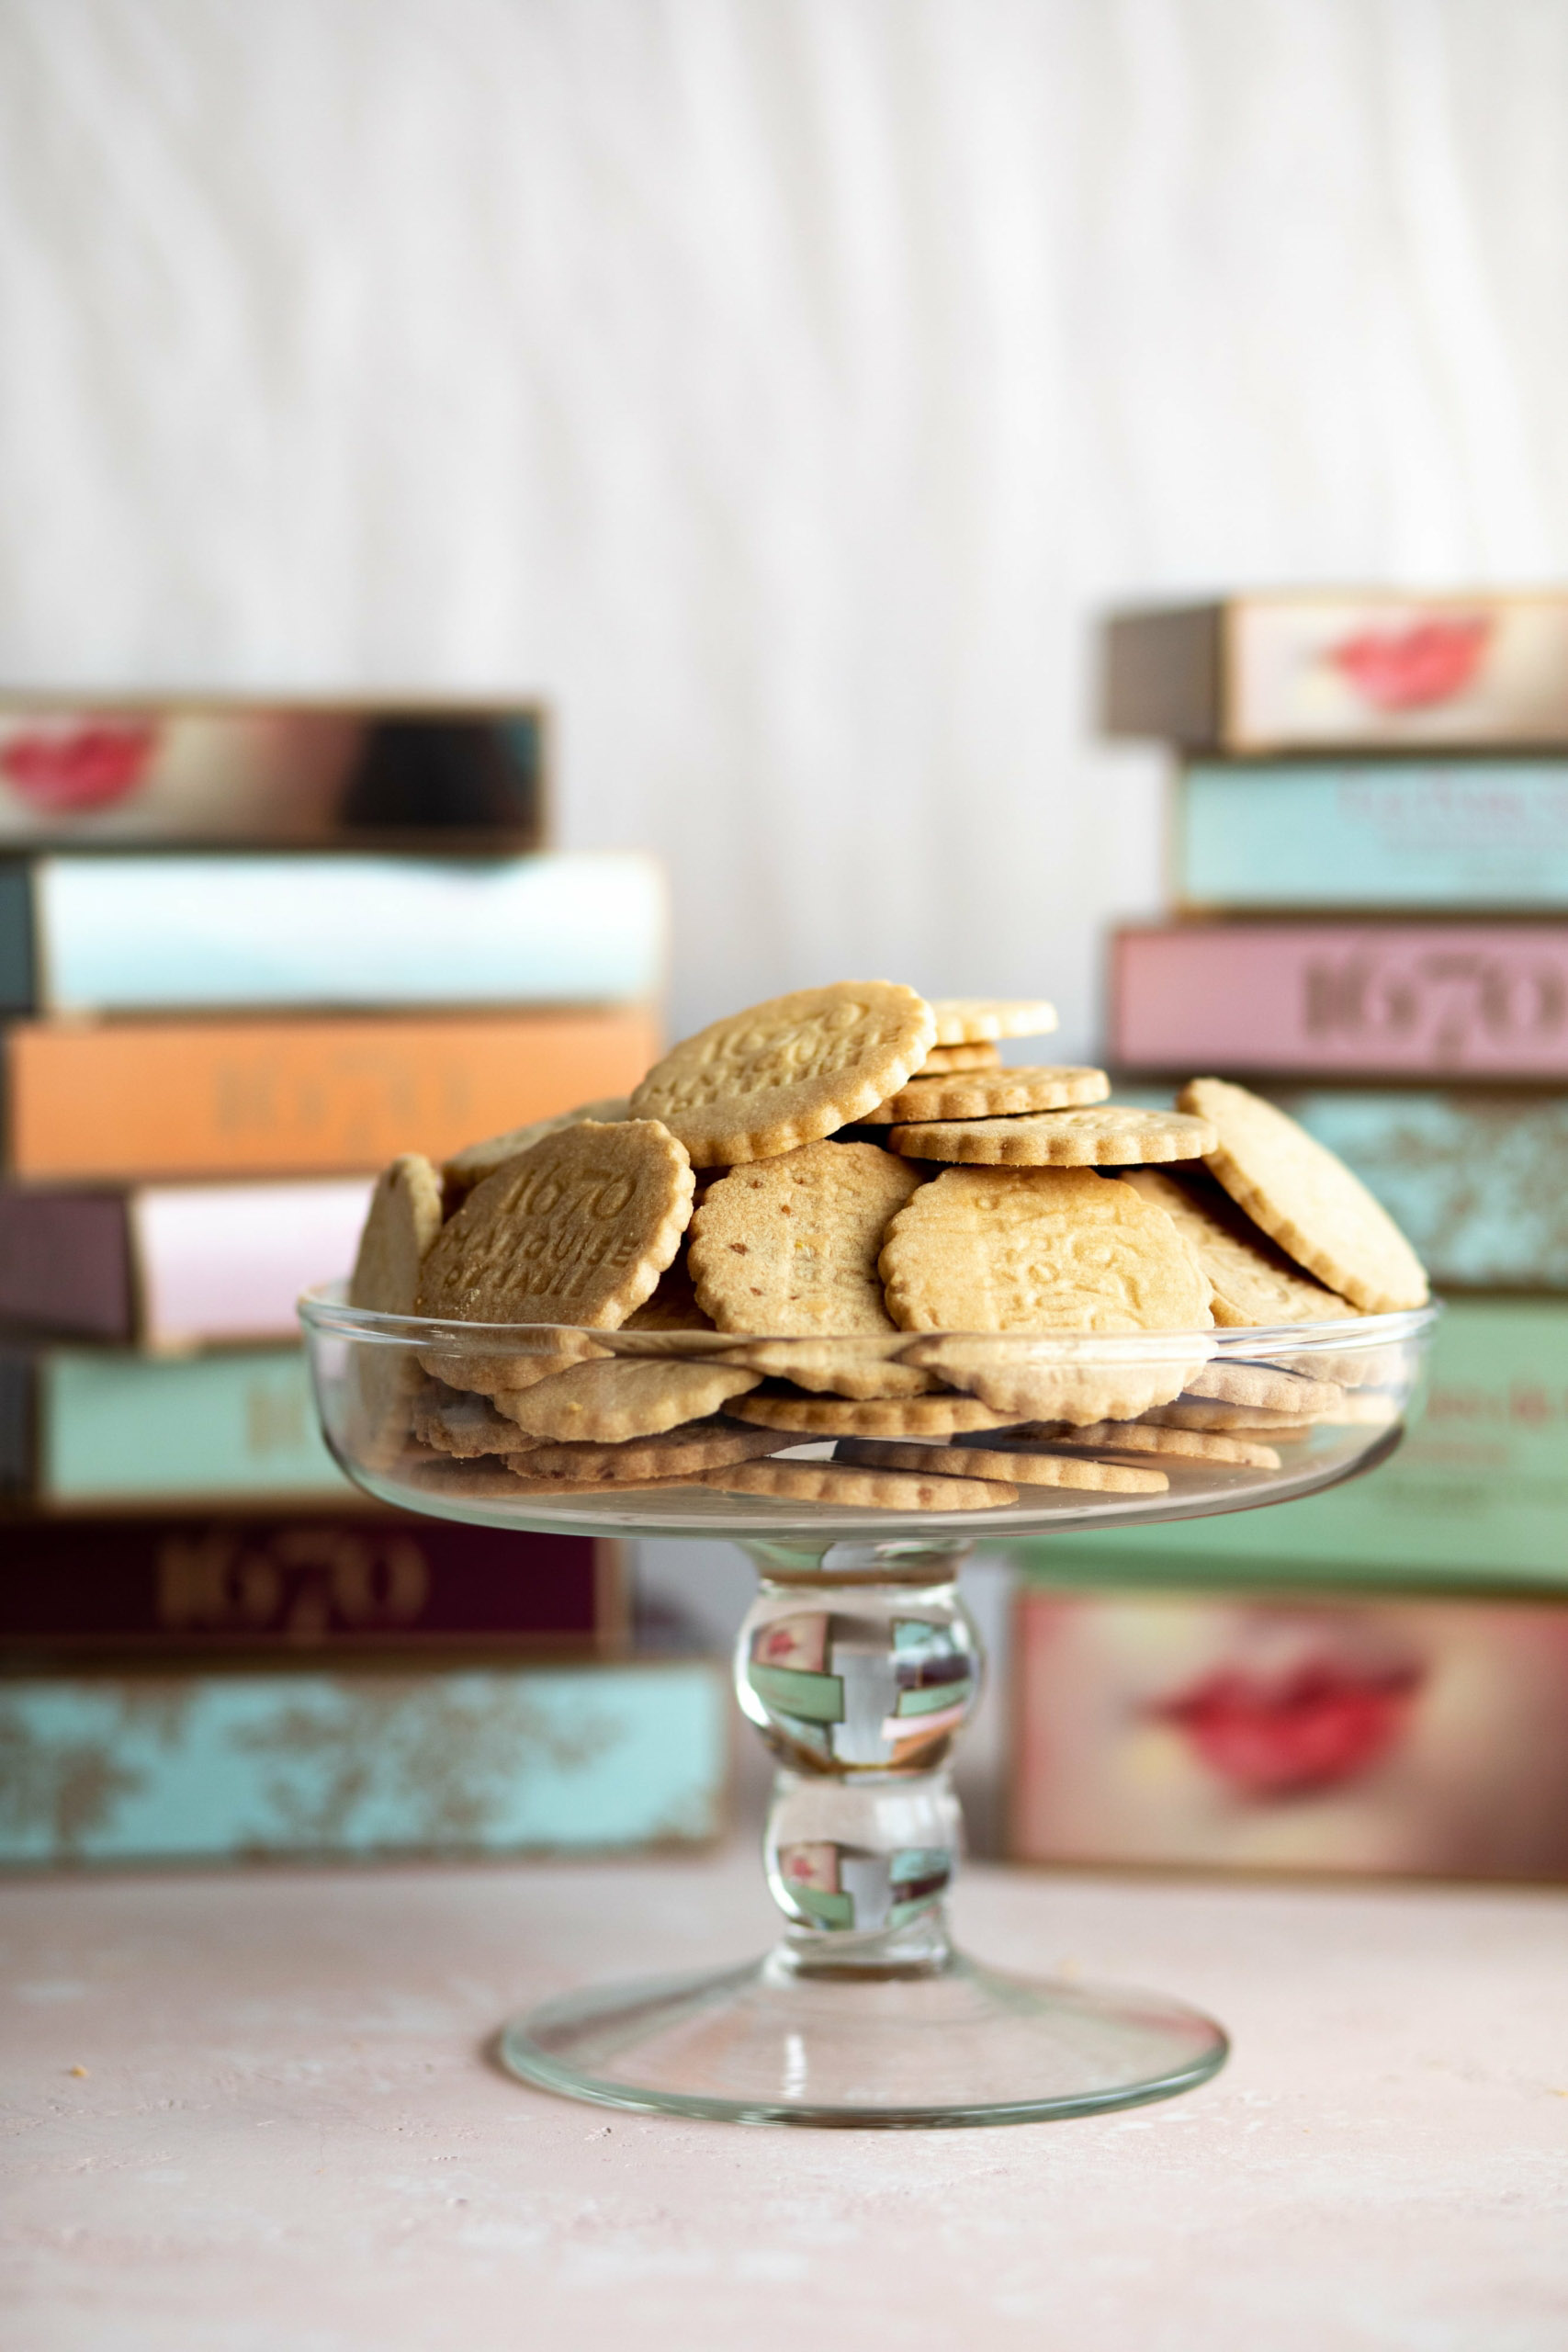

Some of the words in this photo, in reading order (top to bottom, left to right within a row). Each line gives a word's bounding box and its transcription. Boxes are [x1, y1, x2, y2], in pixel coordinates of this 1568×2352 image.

[1303, 946, 1568, 1077] 1670
[212, 1046, 472, 1152] 1670
[503, 1160, 638, 1229] 1670
[158, 1530, 428, 1646] 1670
